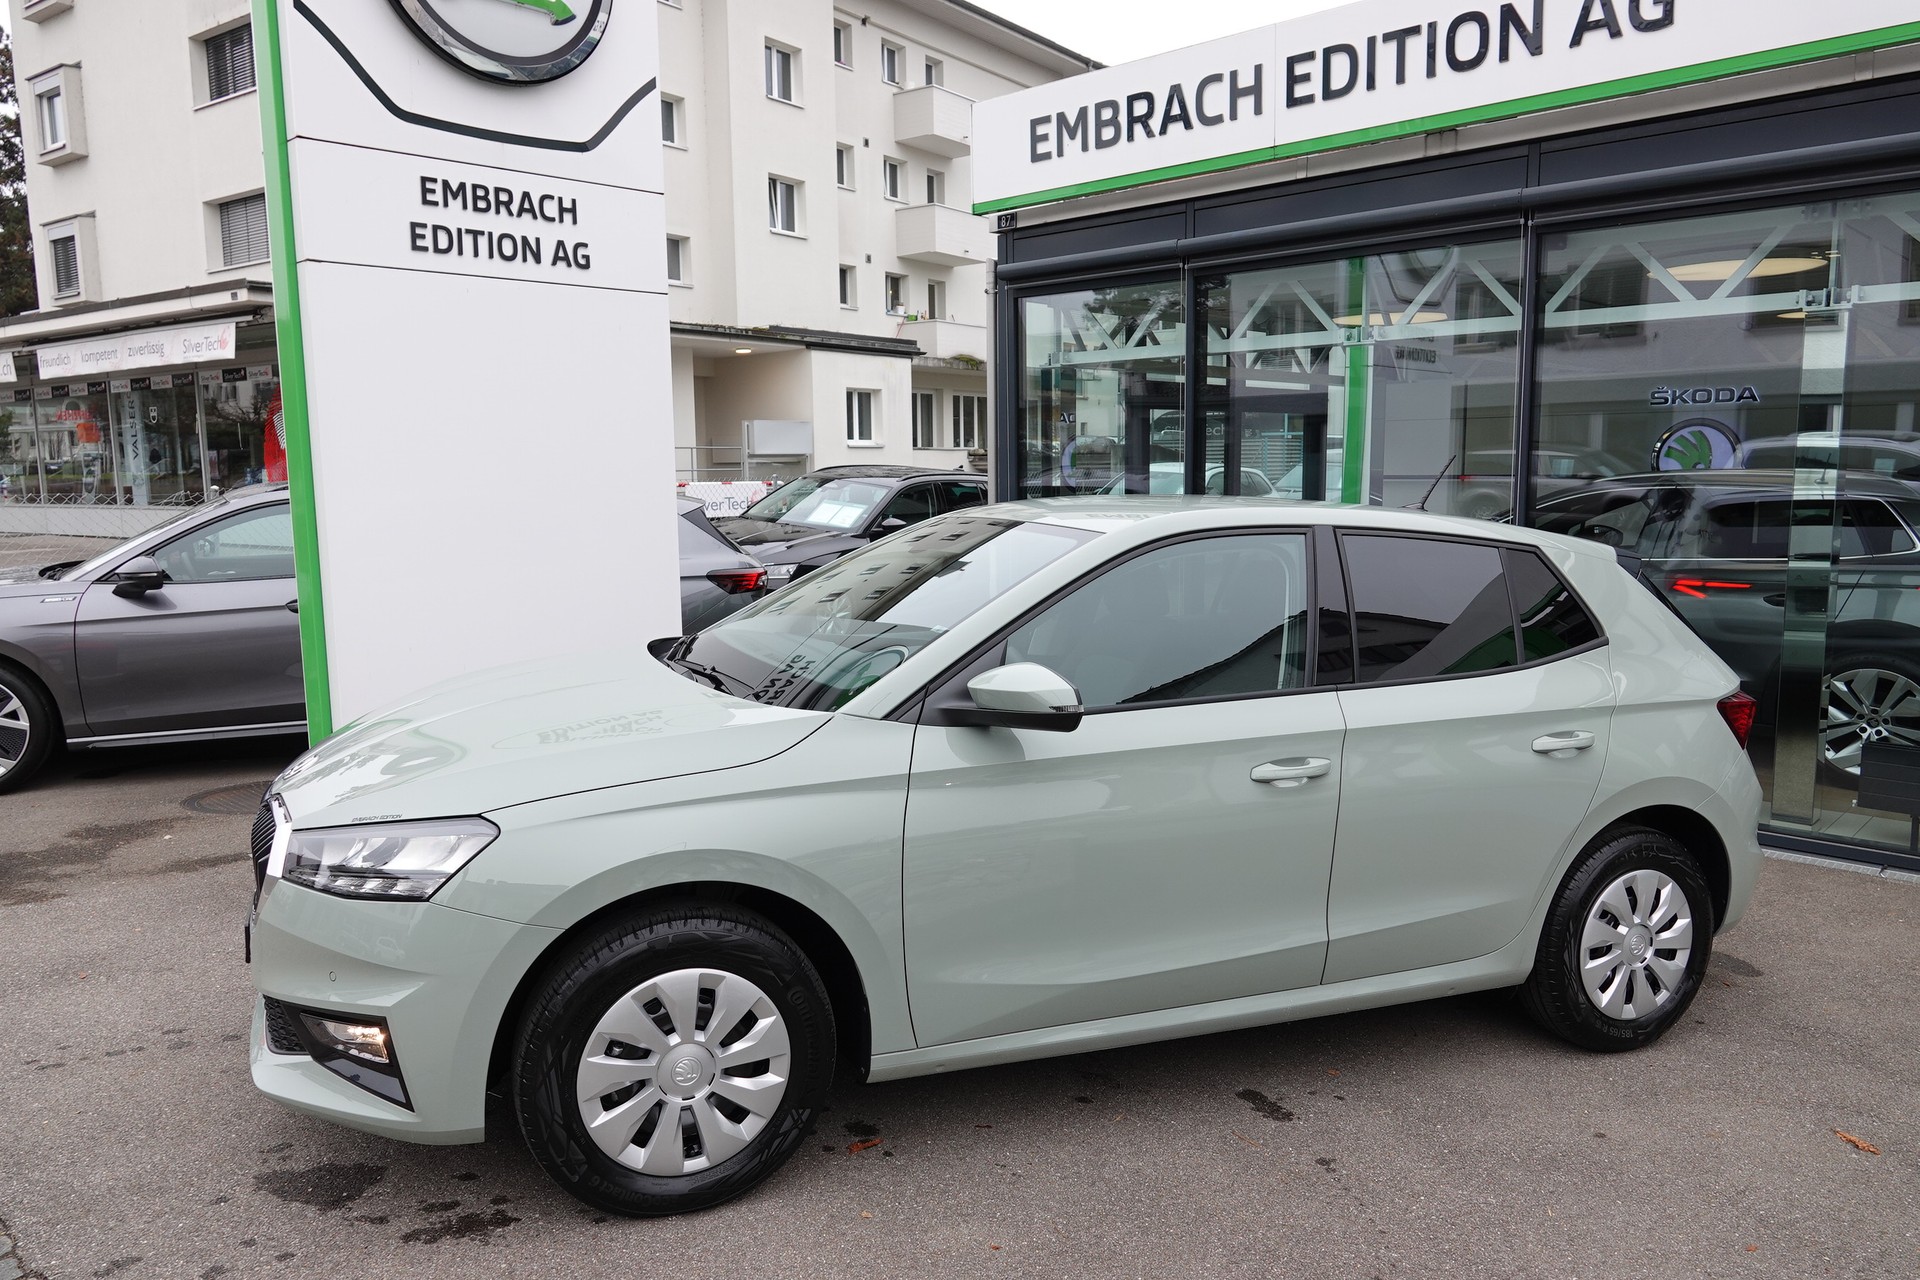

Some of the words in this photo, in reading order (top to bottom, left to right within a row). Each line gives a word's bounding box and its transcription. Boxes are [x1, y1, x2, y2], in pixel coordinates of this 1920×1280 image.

[1030, 63, 1263, 163] EMBRACH
[1286, 0, 1544, 108] EDITION
[1570, 0, 1674, 48] AG
[420, 176, 578, 225] EMBRACH
[1001, 214, 1011, 227] 87
[410, 221, 542, 264] EDITION
[551, 239, 591, 270] AG
[40, 354, 71, 369] freundlich
[80, 348, 118, 365] kompetent
[1649, 386, 1758, 406] ŠKODA
